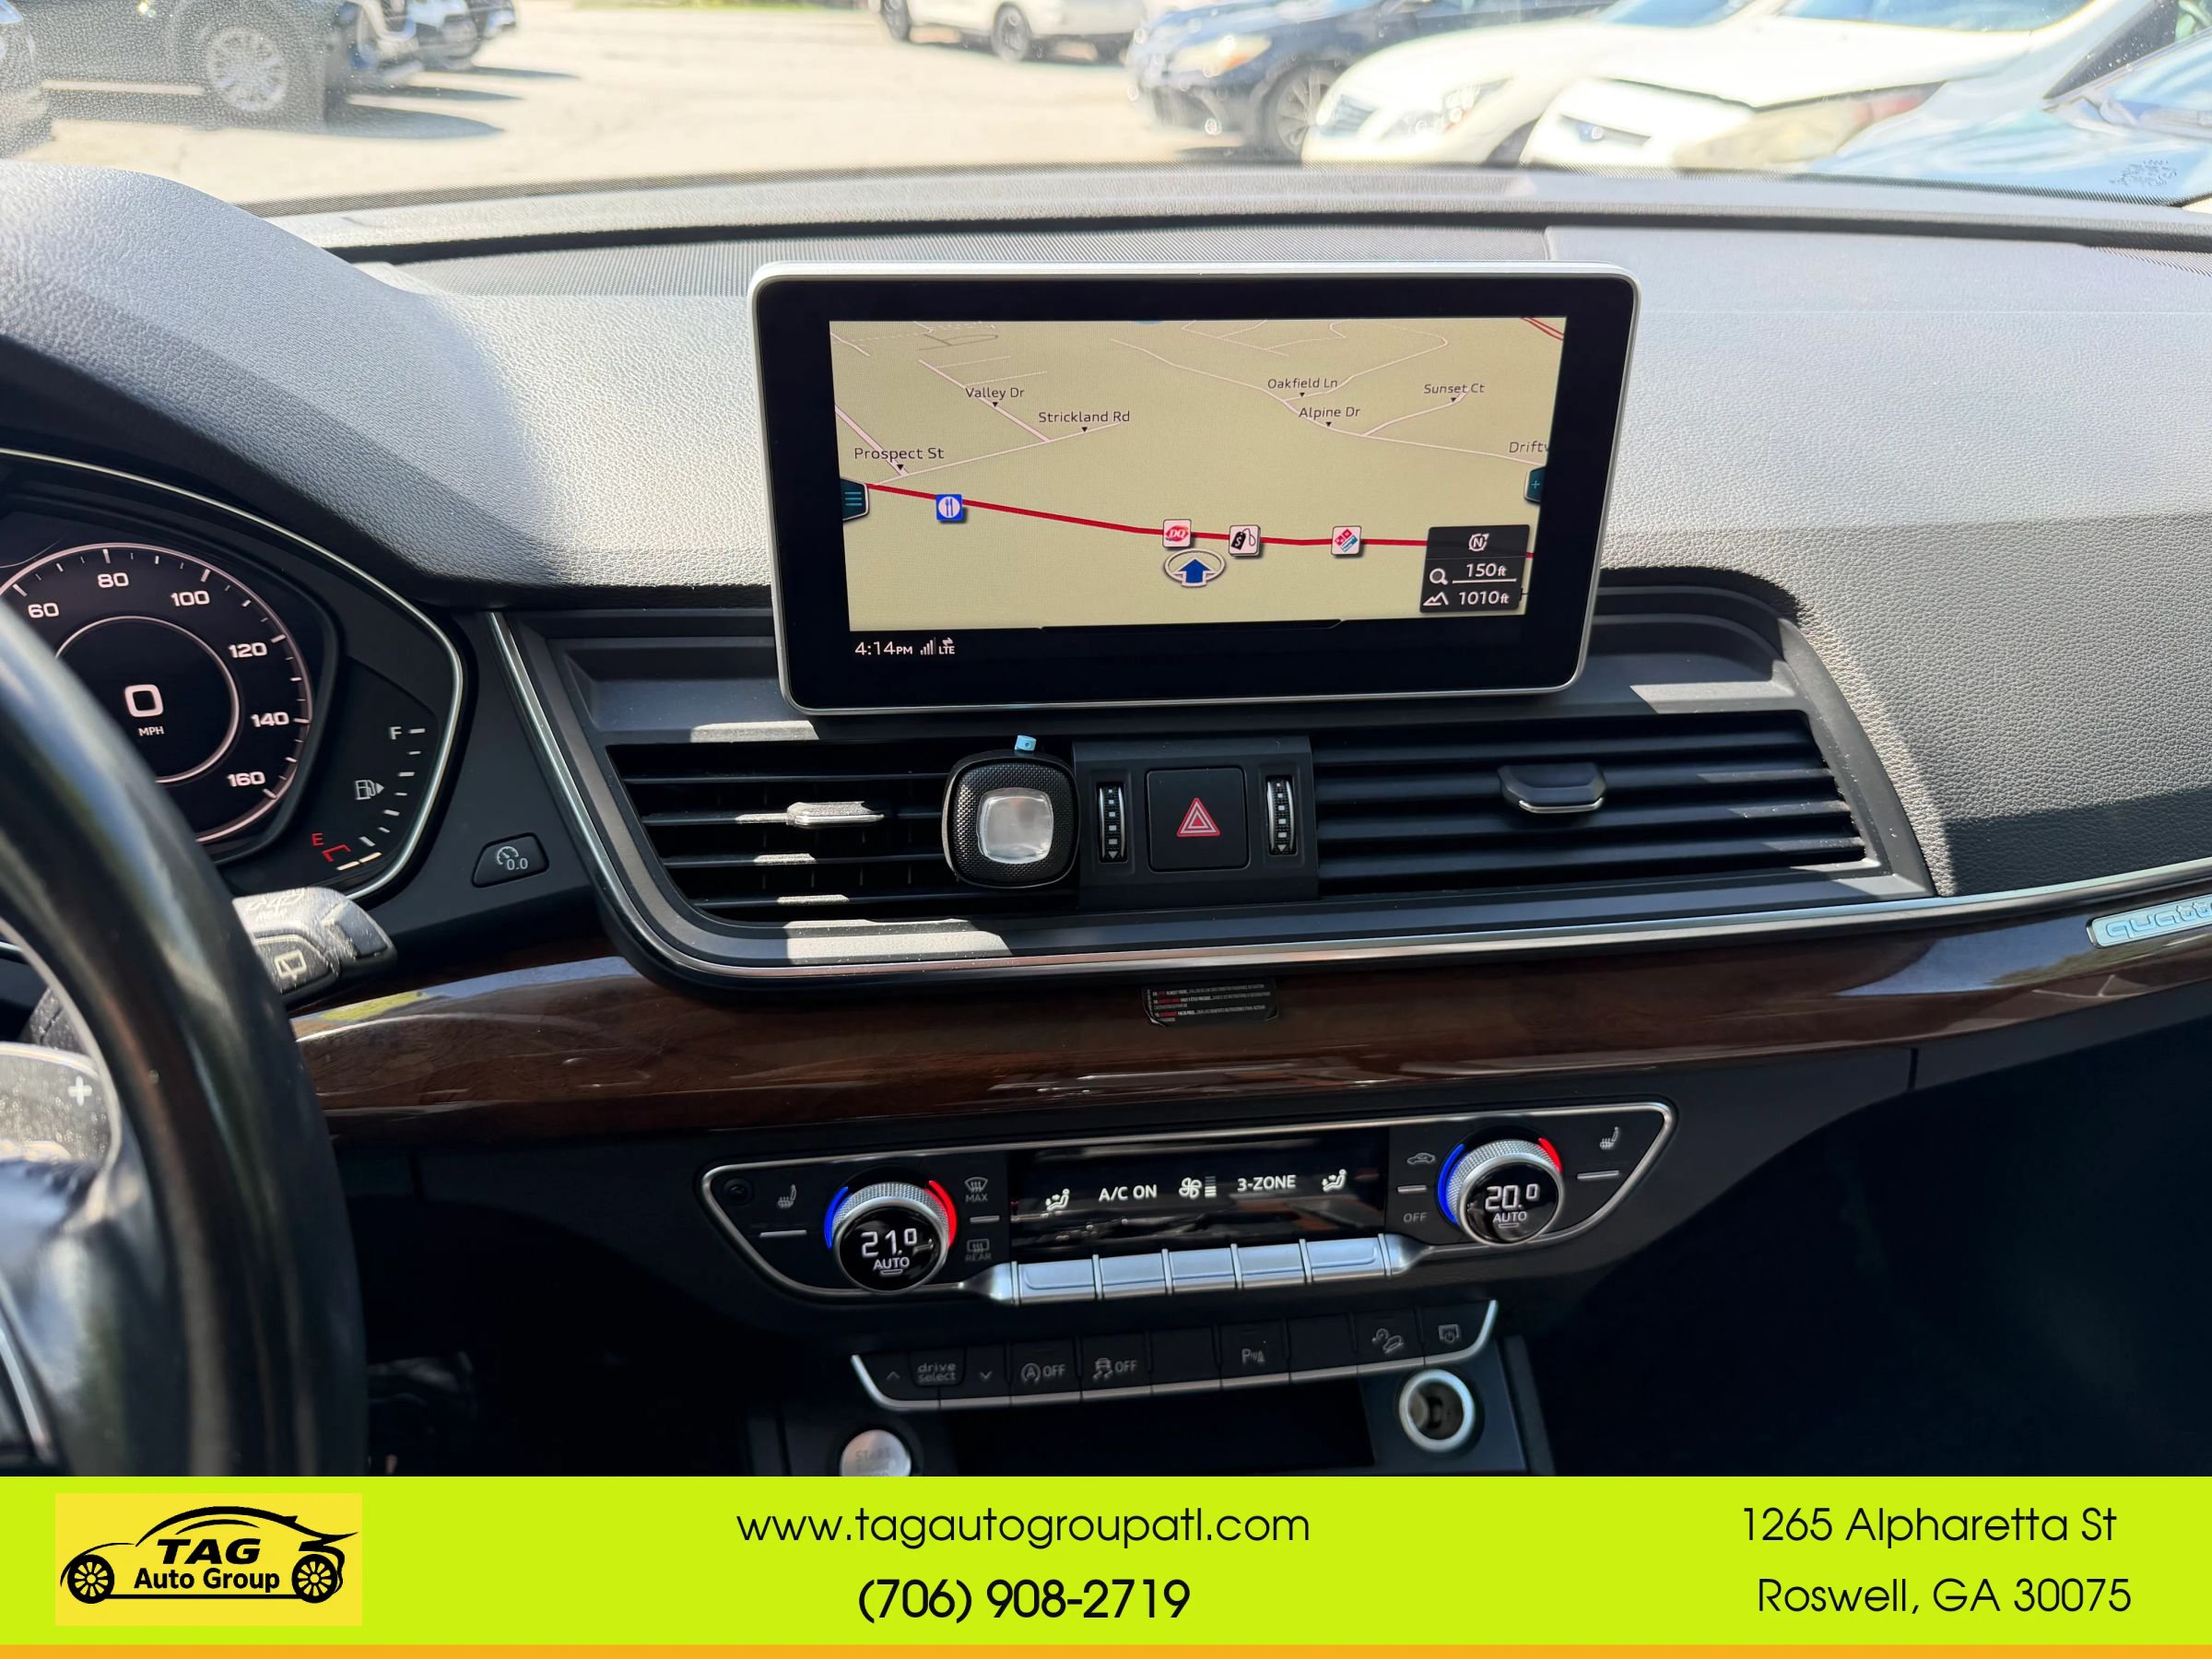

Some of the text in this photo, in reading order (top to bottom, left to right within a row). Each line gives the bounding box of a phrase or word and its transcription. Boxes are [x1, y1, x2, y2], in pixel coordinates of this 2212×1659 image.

[1267, 377, 1337, 389] Oakfield Ln
[1424, 383, 1485, 394] Sunset Ct
[965, 387, 1024, 400] Valley Dr
[1039, 411, 1130, 423] Strickland Rd
[1299, 406, 1360, 419] Alpine Dr
[854, 447, 944, 460] Prospect St
[98, 572, 129, 588] 80
[171, 590, 210, 607] 100
[28, 602, 59, 618] 60
[229, 642, 267, 658] 120
[938, 644, 955, 654] LTE
[124, 684, 164, 717] 0
[252, 712, 289, 727] 140
[138, 725, 164, 736] MPH
[390, 726, 403, 739] F
[228, 771, 265, 786] 160
[312, 833, 324, 846] E
[506, 857, 528, 871] 0.0
[2106, 902, 2212, 939] quatt
[1238, 1175, 1297, 1191] 3-ZONE
[965, 1193, 988, 1203] MAX
[1099, 1184, 1158, 1201] A/C ON
[1404, 1212, 1427, 1223] OFF
[1493, 1211, 1527, 1222] AUTO
[873, 1256, 910, 1270] AUTO
[965, 1253, 991, 1262] REAR
[917, 1362, 957, 1372] drive
[1042, 1364, 1065, 1377] OFF
[1114, 1360, 1138, 1373] OFF
[917, 1371, 956, 1382] select
